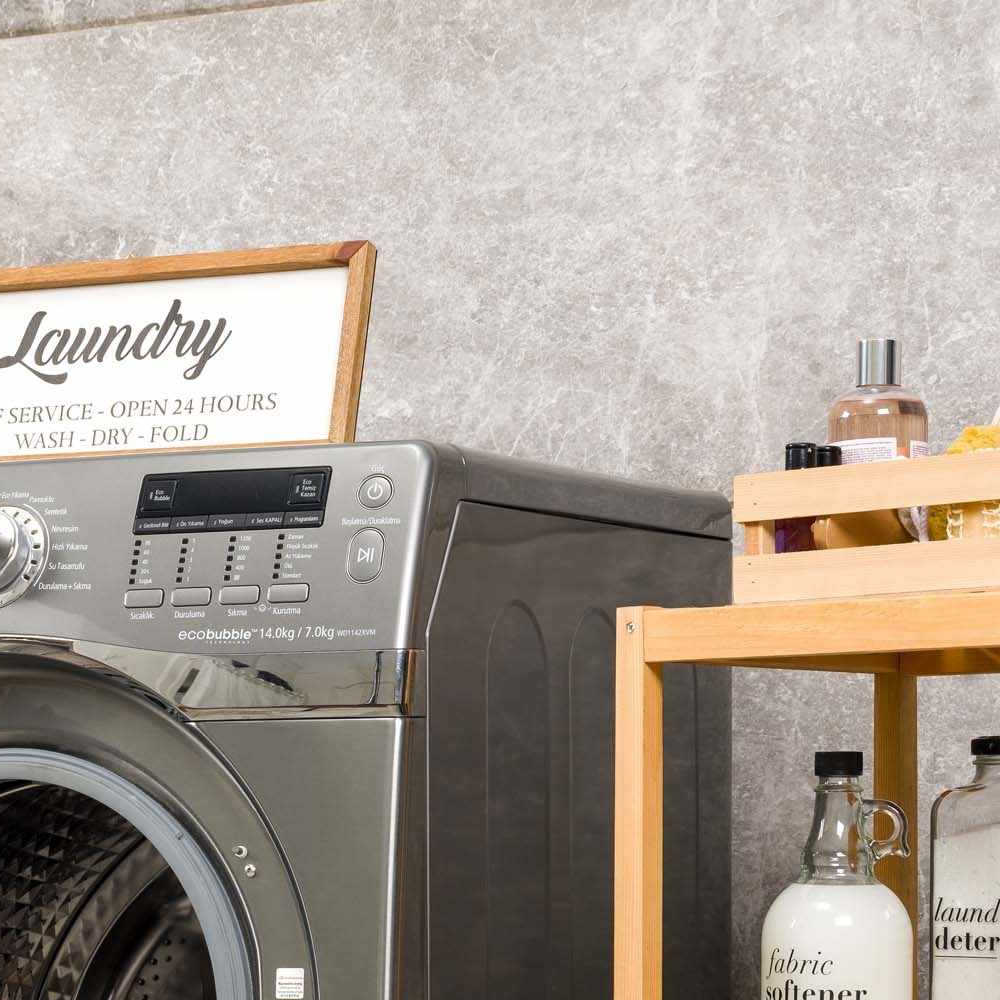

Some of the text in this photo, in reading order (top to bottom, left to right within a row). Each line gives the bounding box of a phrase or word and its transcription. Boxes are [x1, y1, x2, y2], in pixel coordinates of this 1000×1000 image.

[8, 403, 93, 424] SERVICE
[110, 398, 168, 419] OPEN
[173, 398, 195, 417] 24
[199, 393, 277, 414] HOURS
[16, 428, 75, 449] WASH
[91, 427, 134, 446] DRY
[150, 424, 209, 443] FOLD
[260, 626, 295, 640] 14.0kg
[306, 626, 334, 640] 7.0kg
[766, 948, 834, 980] fabric
